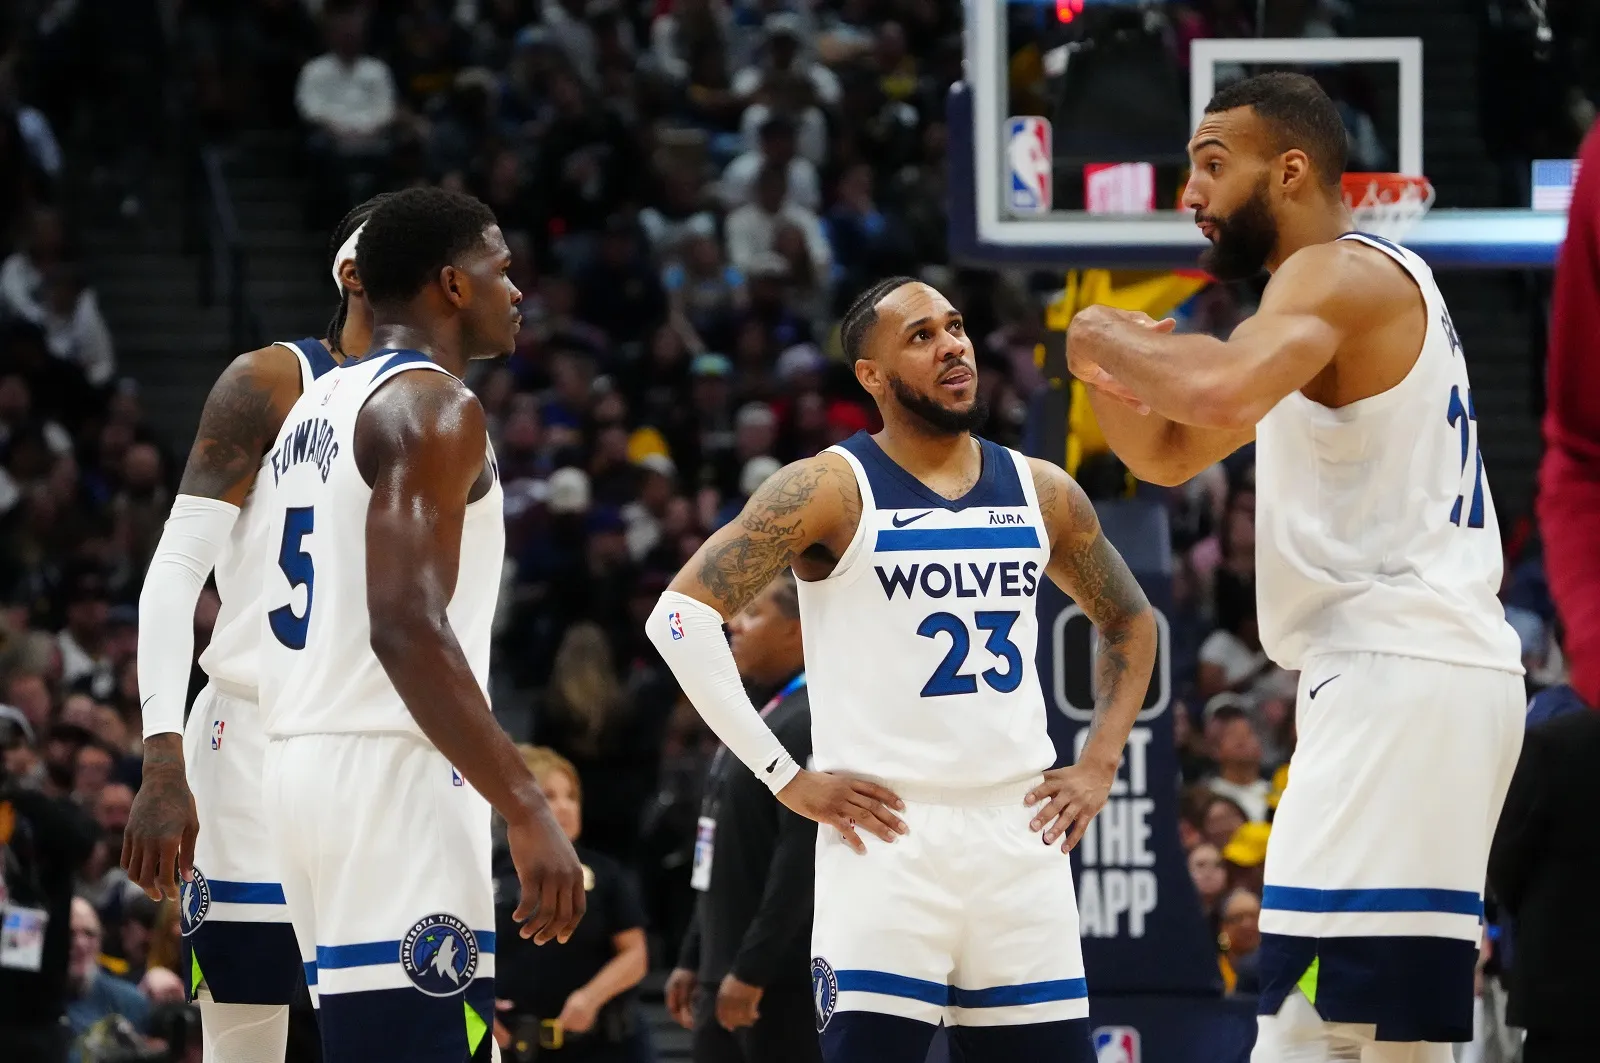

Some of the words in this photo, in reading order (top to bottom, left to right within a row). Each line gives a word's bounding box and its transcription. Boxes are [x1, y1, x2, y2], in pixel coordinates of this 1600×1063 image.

[742, 514, 803, 537] Blood
[268, 505, 314, 650] 5
[874, 561, 1038, 601] WOLVES
[916, 610, 1023, 697] 23
[1078, 868, 1158, 938] APP
[403, 918, 434, 971] MINNESOTA
[439, 915, 477, 978] TIMBERWOLVES
